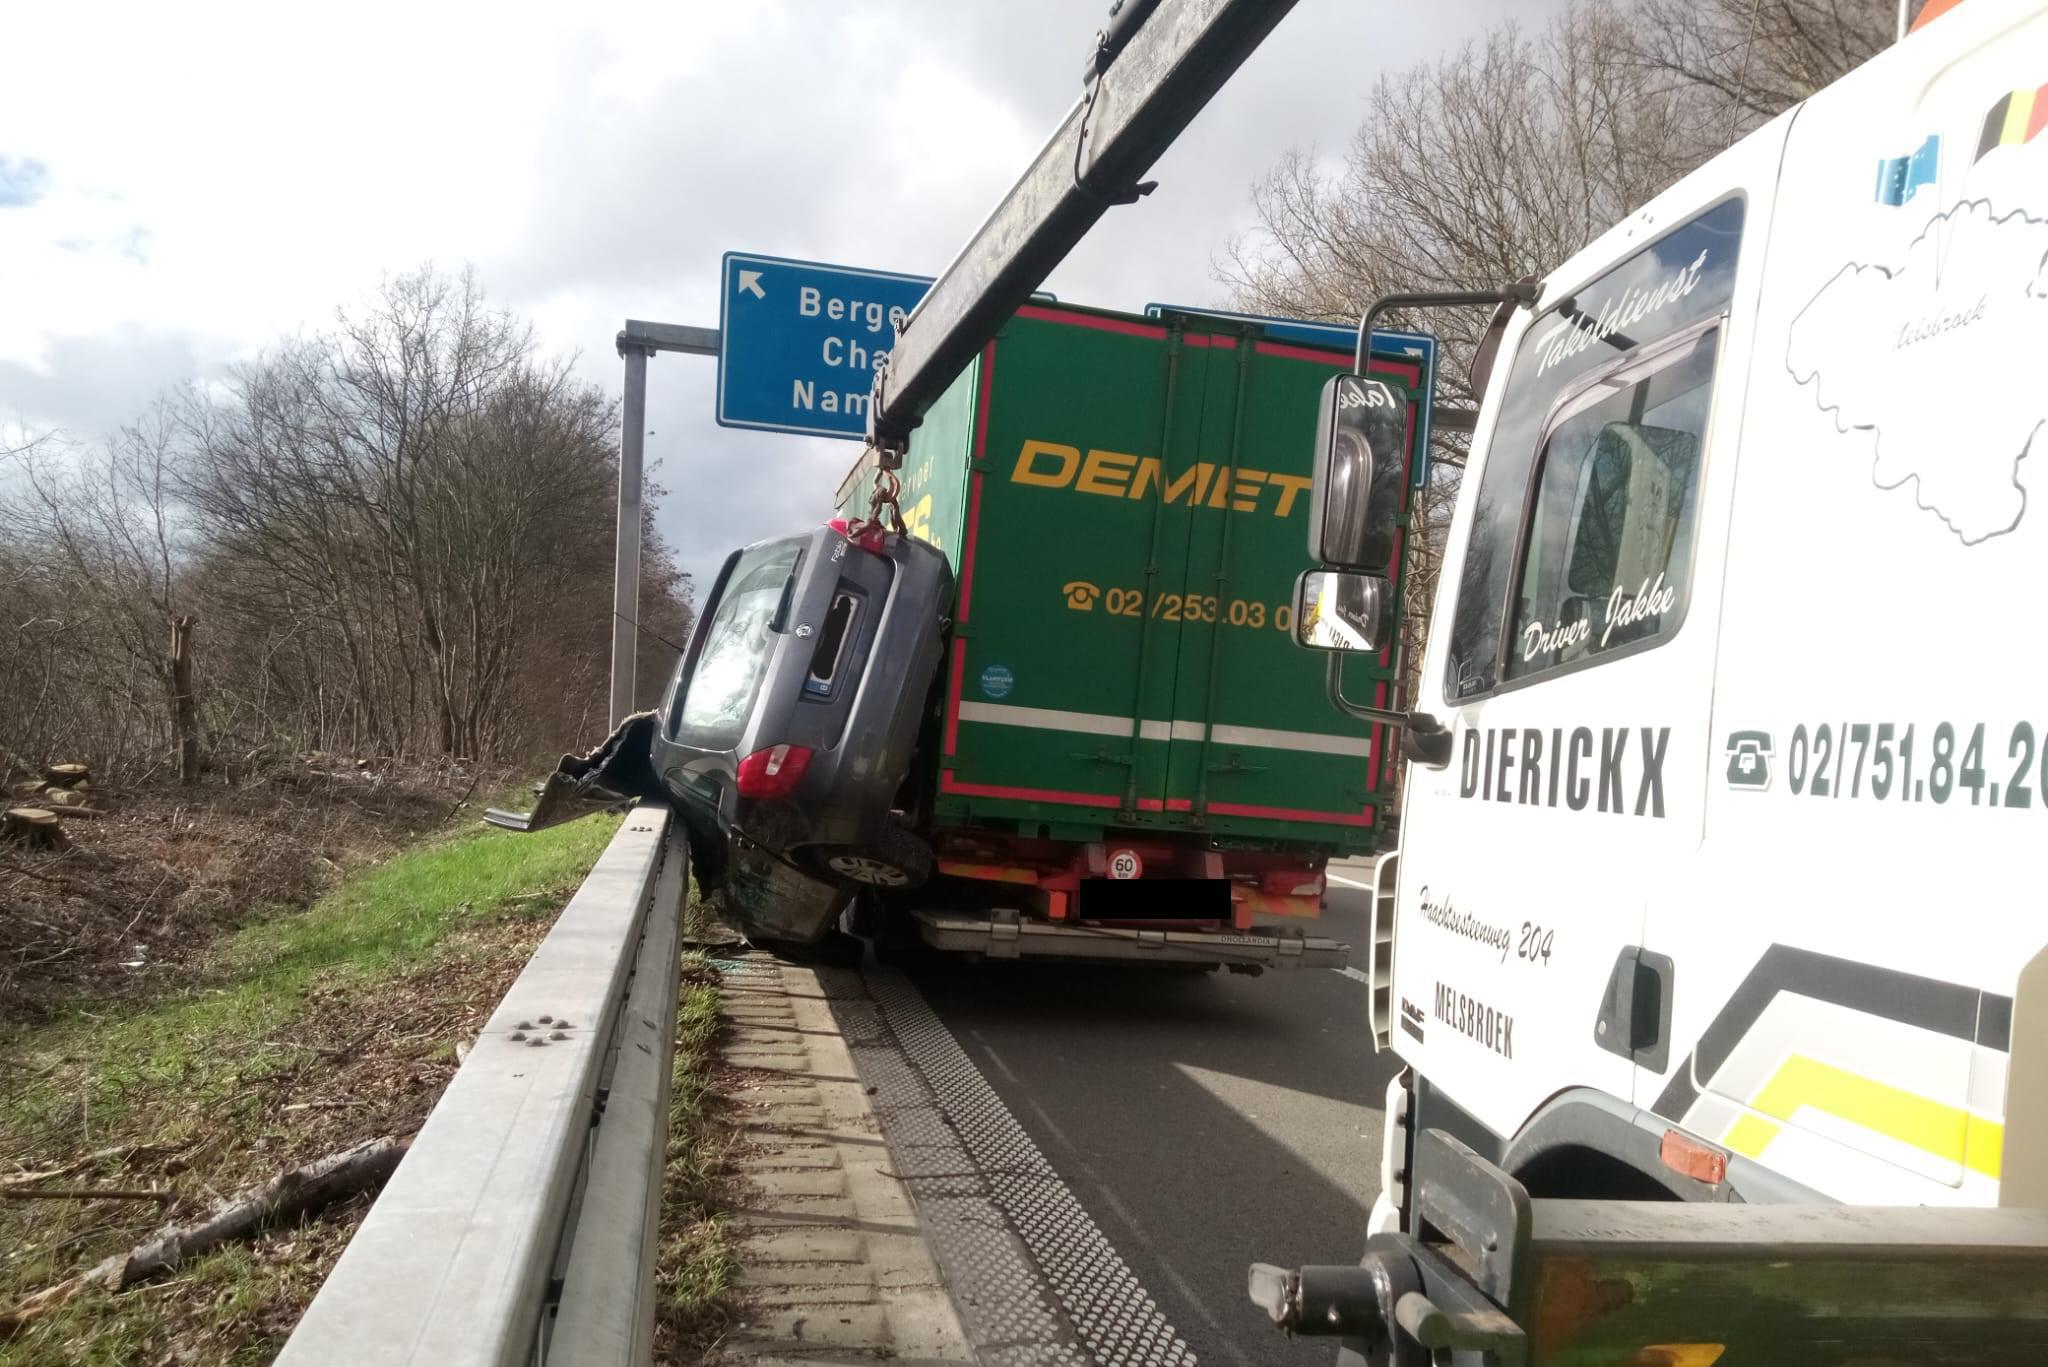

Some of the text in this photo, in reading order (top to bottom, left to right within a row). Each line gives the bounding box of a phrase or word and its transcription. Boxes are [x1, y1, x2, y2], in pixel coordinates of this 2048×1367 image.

[800, 286, 908, 333] Berge
[1536, 249, 1707, 377] Takeldienst
[1524, 571, 1675, 662] Driver Jakke
[1459, 726, 1672, 818] DIERICKX
[1115, 858, 1133, 872] 60
[1518, 921, 1554, 967] 204
[1434, 980, 1514, 1060] MELSBROEK
